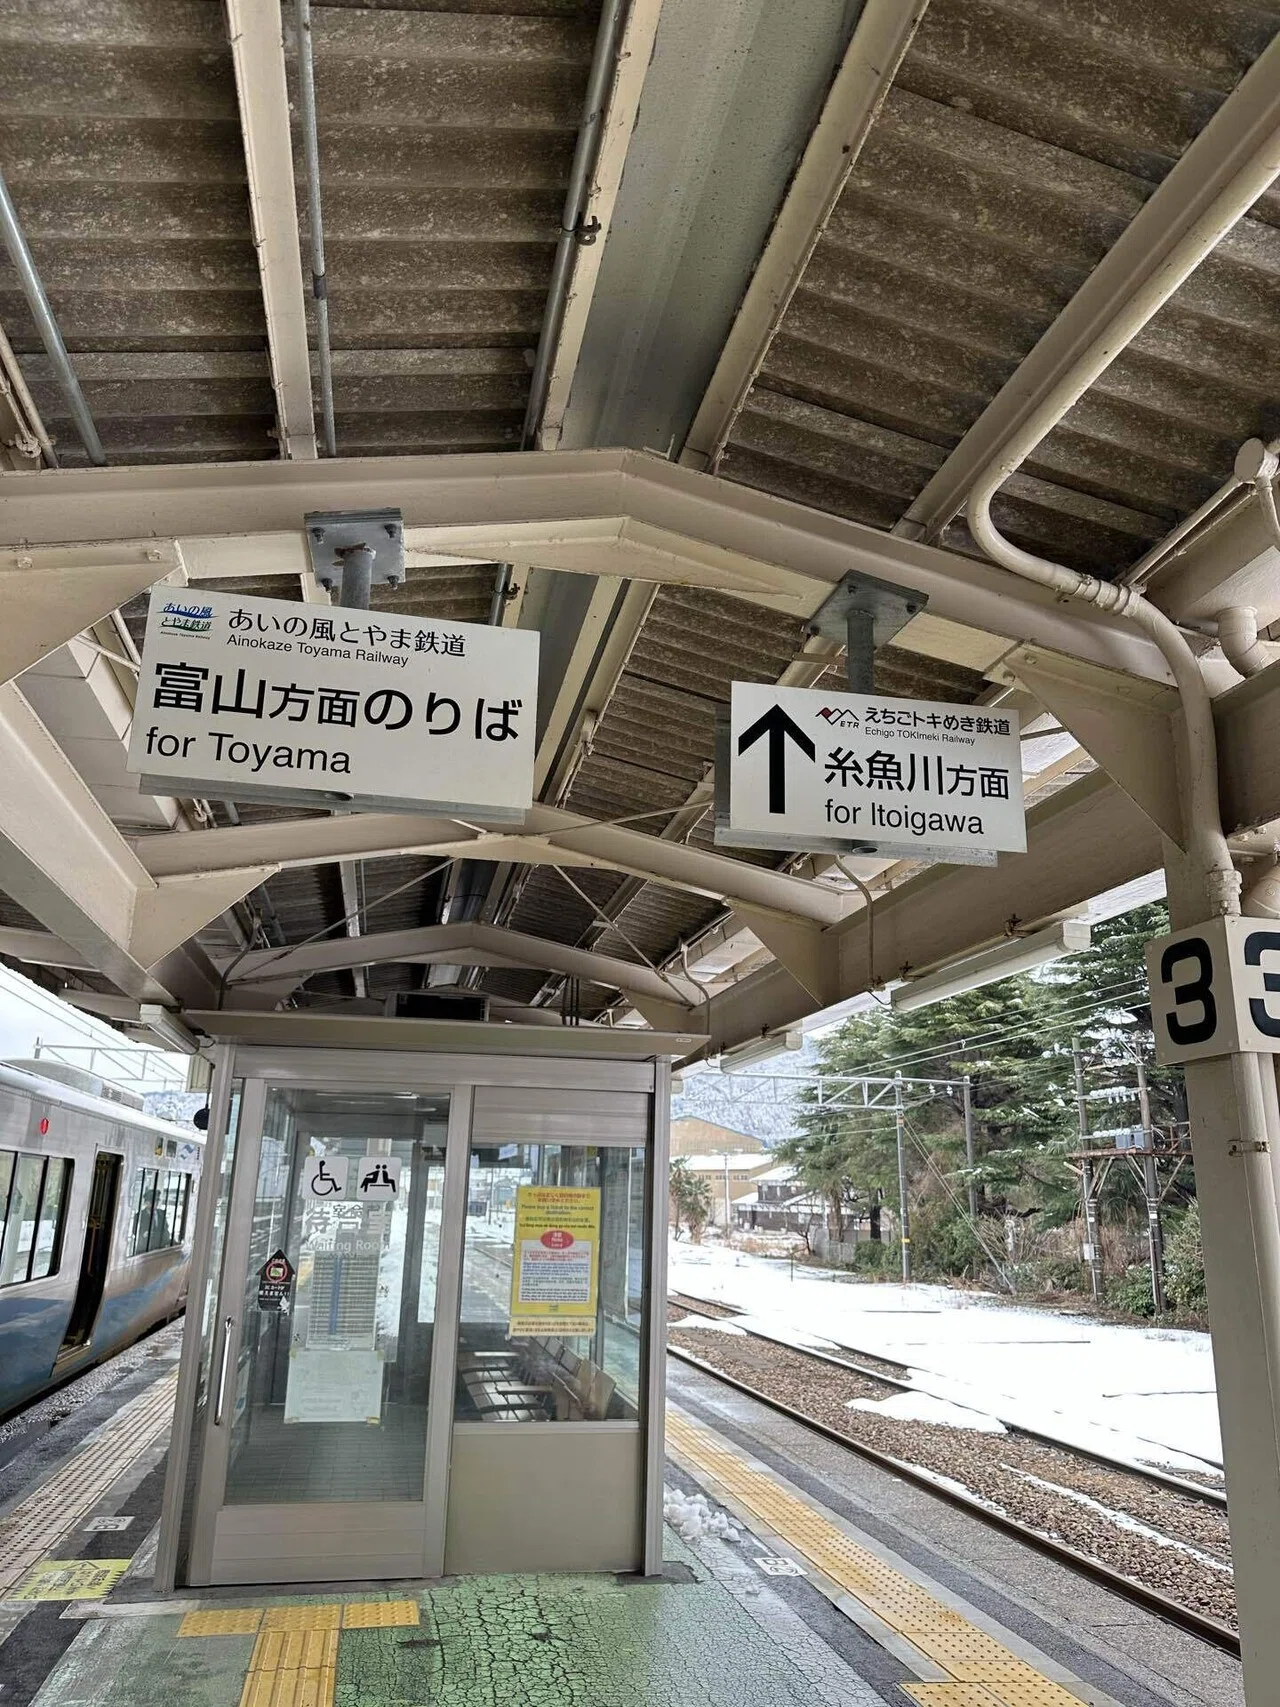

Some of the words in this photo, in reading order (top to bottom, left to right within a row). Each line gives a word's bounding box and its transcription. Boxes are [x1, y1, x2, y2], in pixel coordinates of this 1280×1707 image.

[161, 617, 212, 630] とやま鉄道
[163, 602, 213, 618] あいの風
[226, 634, 292, 653] Ainokaze
[297, 641, 351, 660] Toyama
[355, 648, 409, 668] Railway
[228, 608, 466, 657] あいの風とやま鉄道
[153, 662, 523, 742] 富山方面のりば
[840, 720, 860, 729] ETR
[864, 707, 1011, 736] えちごトキめき鉄道
[865, 726, 895, 739] Echigo
[942, 734, 976, 746] Railway
[146, 726, 196, 758] for
[208, 732, 351, 774] Toyama
[824, 746, 1009, 800] 糸魚川方面
[825, 799, 862, 824] for
[871, 802, 984, 836] Itoigawa
[1161, 937, 1218, 1045] 3
[1244, 931, 1280, 1038] 3
